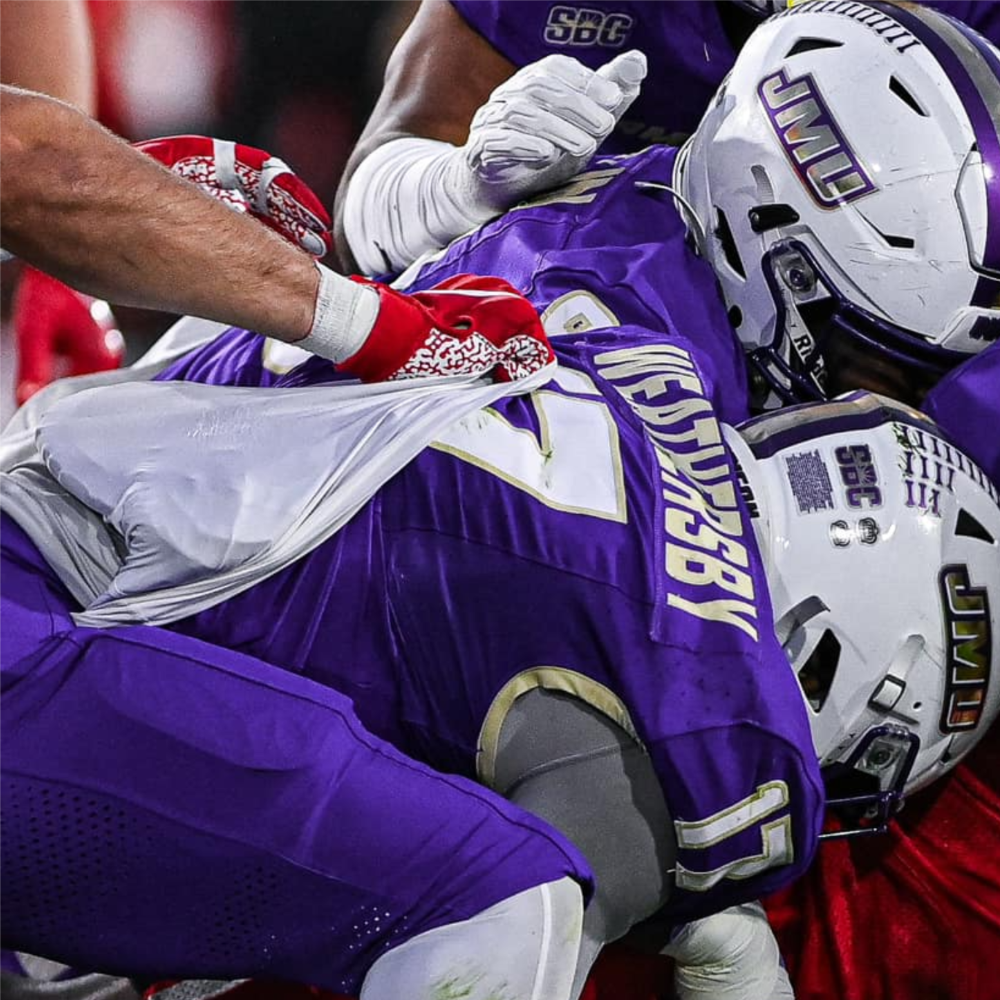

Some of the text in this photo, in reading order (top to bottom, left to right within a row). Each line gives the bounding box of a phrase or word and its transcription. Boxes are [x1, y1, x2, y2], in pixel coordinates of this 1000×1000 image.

[544, 6, 633, 46] SBC
[757, 67, 877, 209] JMU
[594, 344, 759, 642] WEATHERSBY
[835, 444, 883, 509] SBC
[940, 564, 990, 734] JMU
[674, 780, 794, 891] 17
